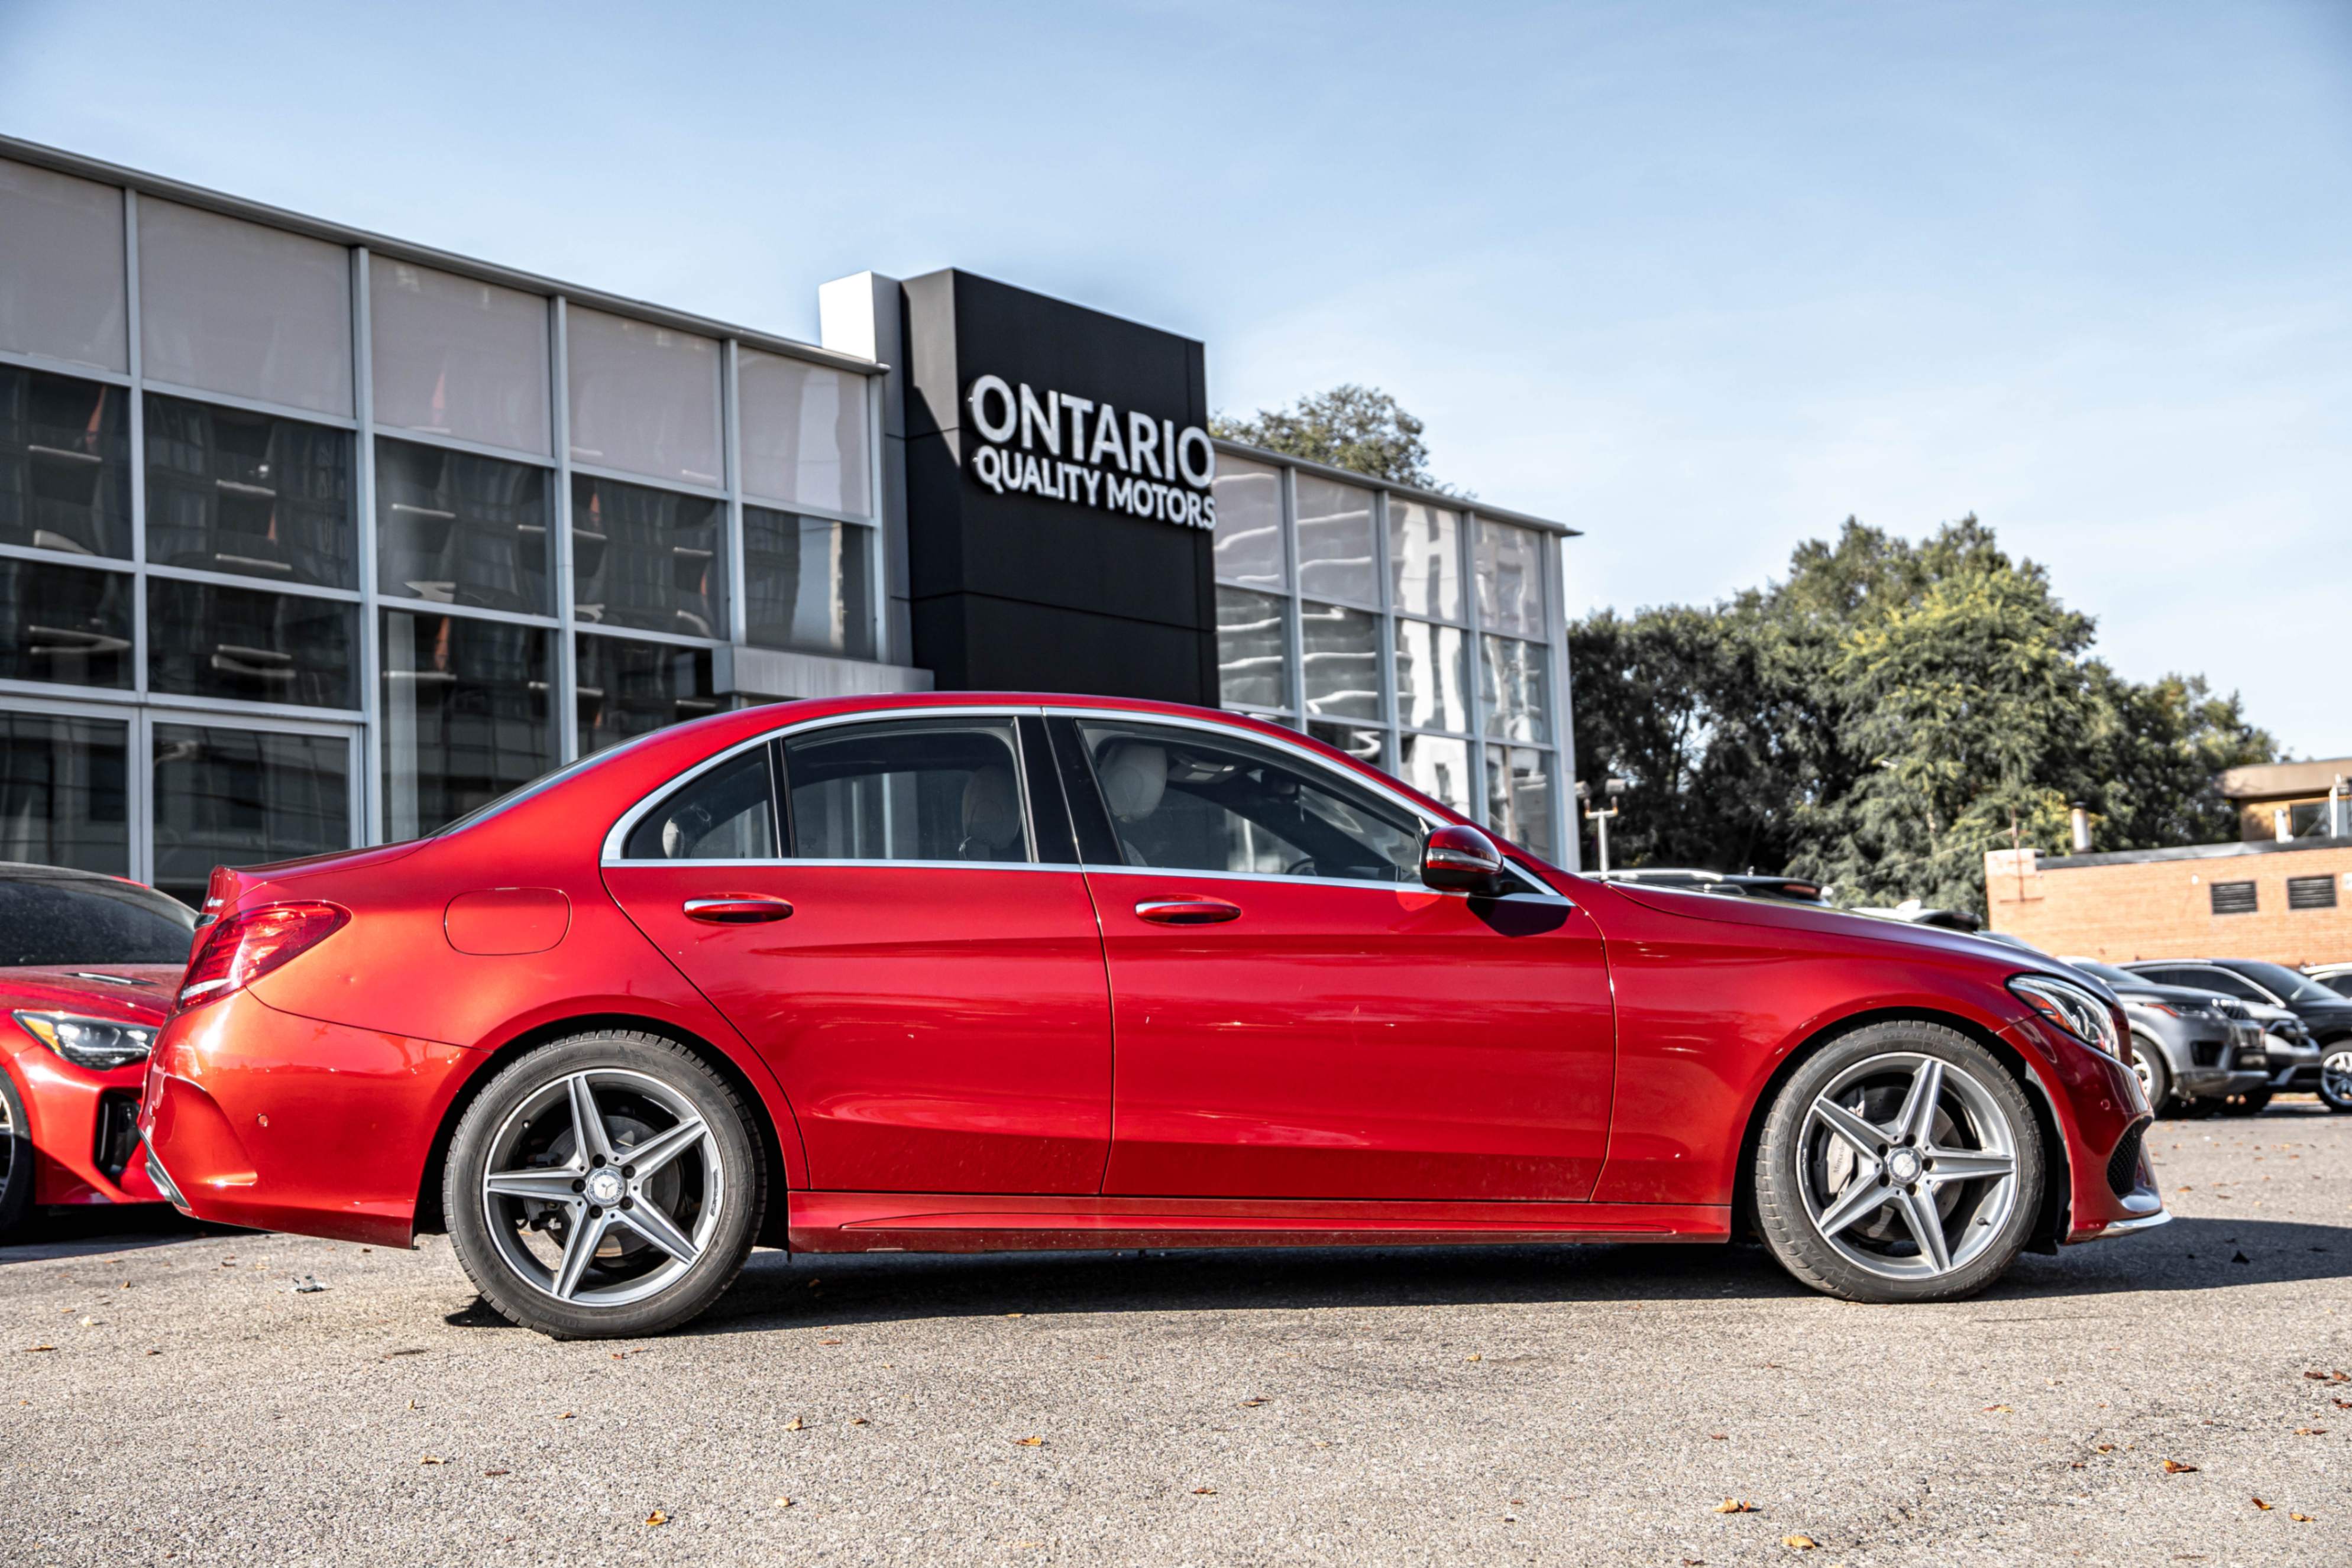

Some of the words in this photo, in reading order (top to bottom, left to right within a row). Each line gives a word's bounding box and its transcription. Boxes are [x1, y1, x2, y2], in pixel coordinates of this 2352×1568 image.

[970, 374, 1216, 489] ONTARIO
[974, 445, 1101, 506] QUALITY
[1107, 472, 1217, 531] MOTORS
